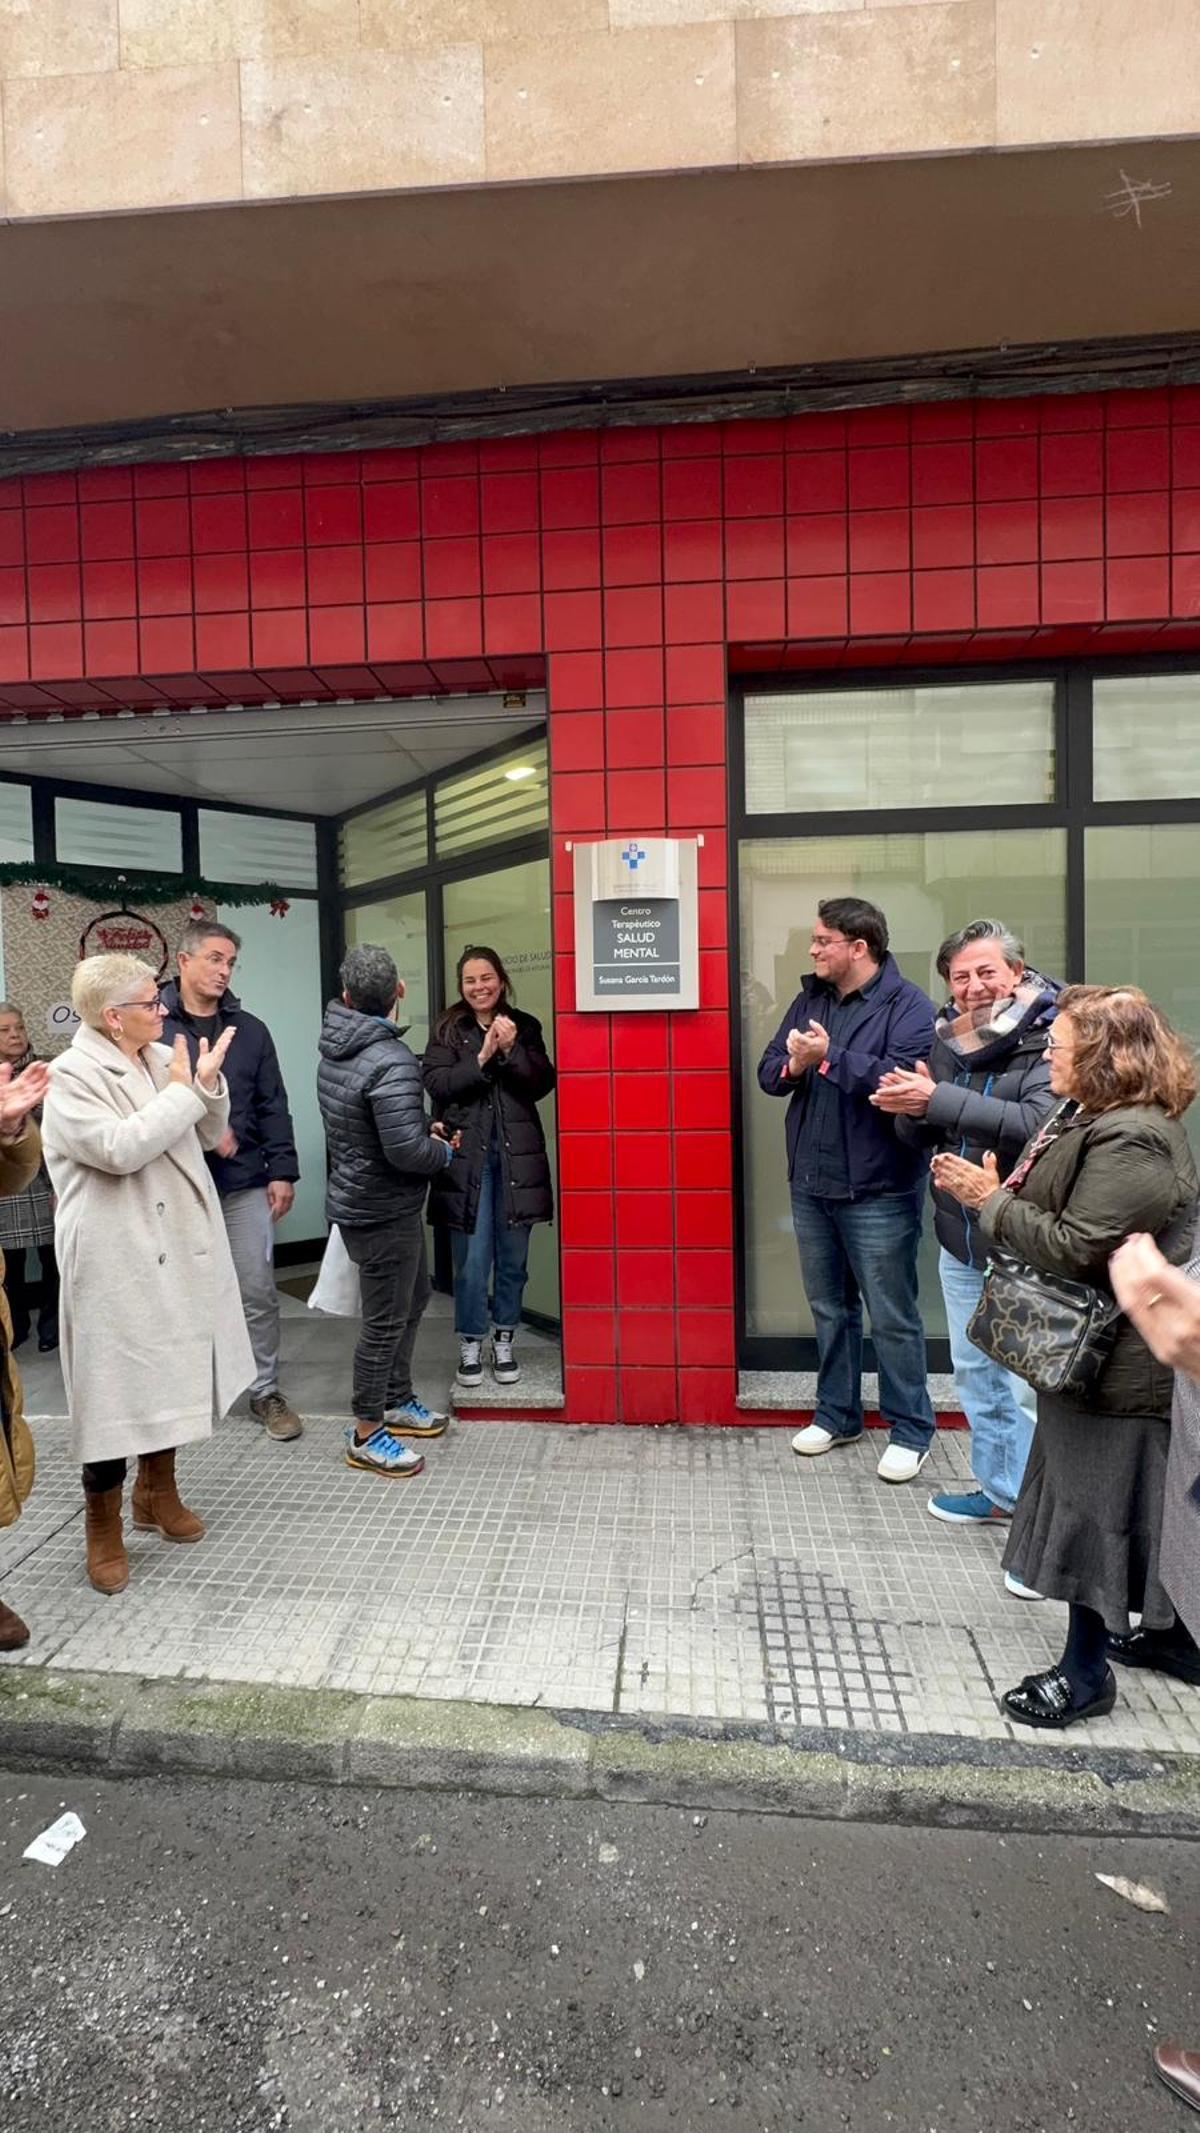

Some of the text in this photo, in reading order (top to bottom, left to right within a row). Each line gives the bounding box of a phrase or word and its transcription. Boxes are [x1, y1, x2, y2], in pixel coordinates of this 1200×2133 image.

[620, 906, 651, 915] Centro
[611, 919, 661, 930] Terapéutico
[617, 932, 655, 943] SALUD
[614, 947, 660, 958] MENTAL
